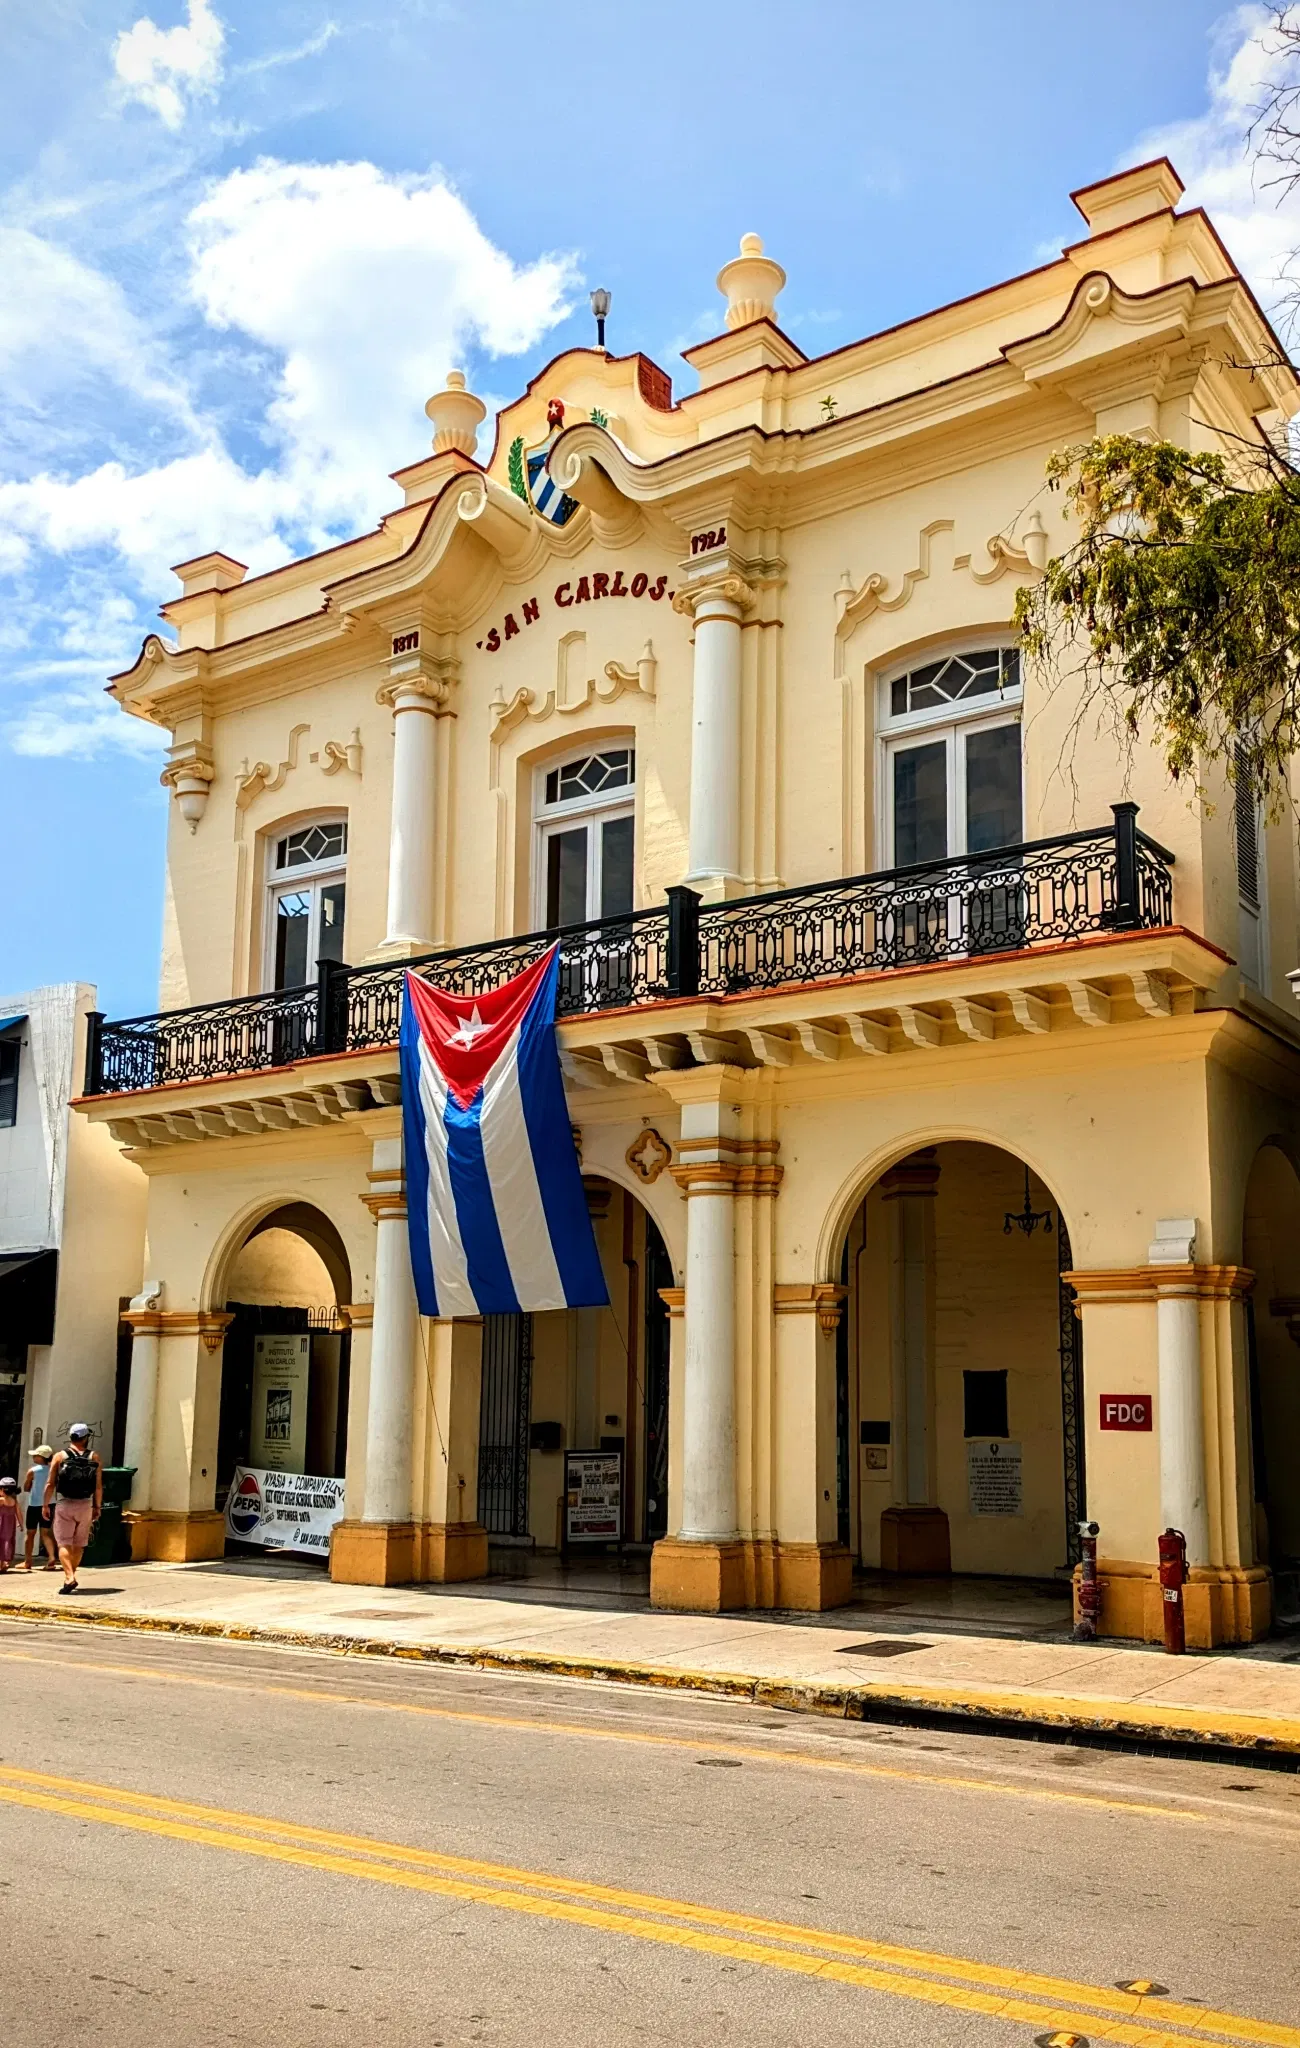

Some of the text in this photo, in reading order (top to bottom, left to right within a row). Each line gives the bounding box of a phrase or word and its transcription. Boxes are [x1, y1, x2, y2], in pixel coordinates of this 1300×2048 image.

[691, 527, 727, 555] 1924
[1105, 1403, 1145, 1423] FDC
[294, 1475, 325, 1493] COMPANY
[233, 1496, 261, 1513] PEPSI
[296, 1492, 313, 1507] SCHOOL
[313, 1494, 336, 1509] REUNION
[276, 1509, 298, 1522] SEPTEMBER
